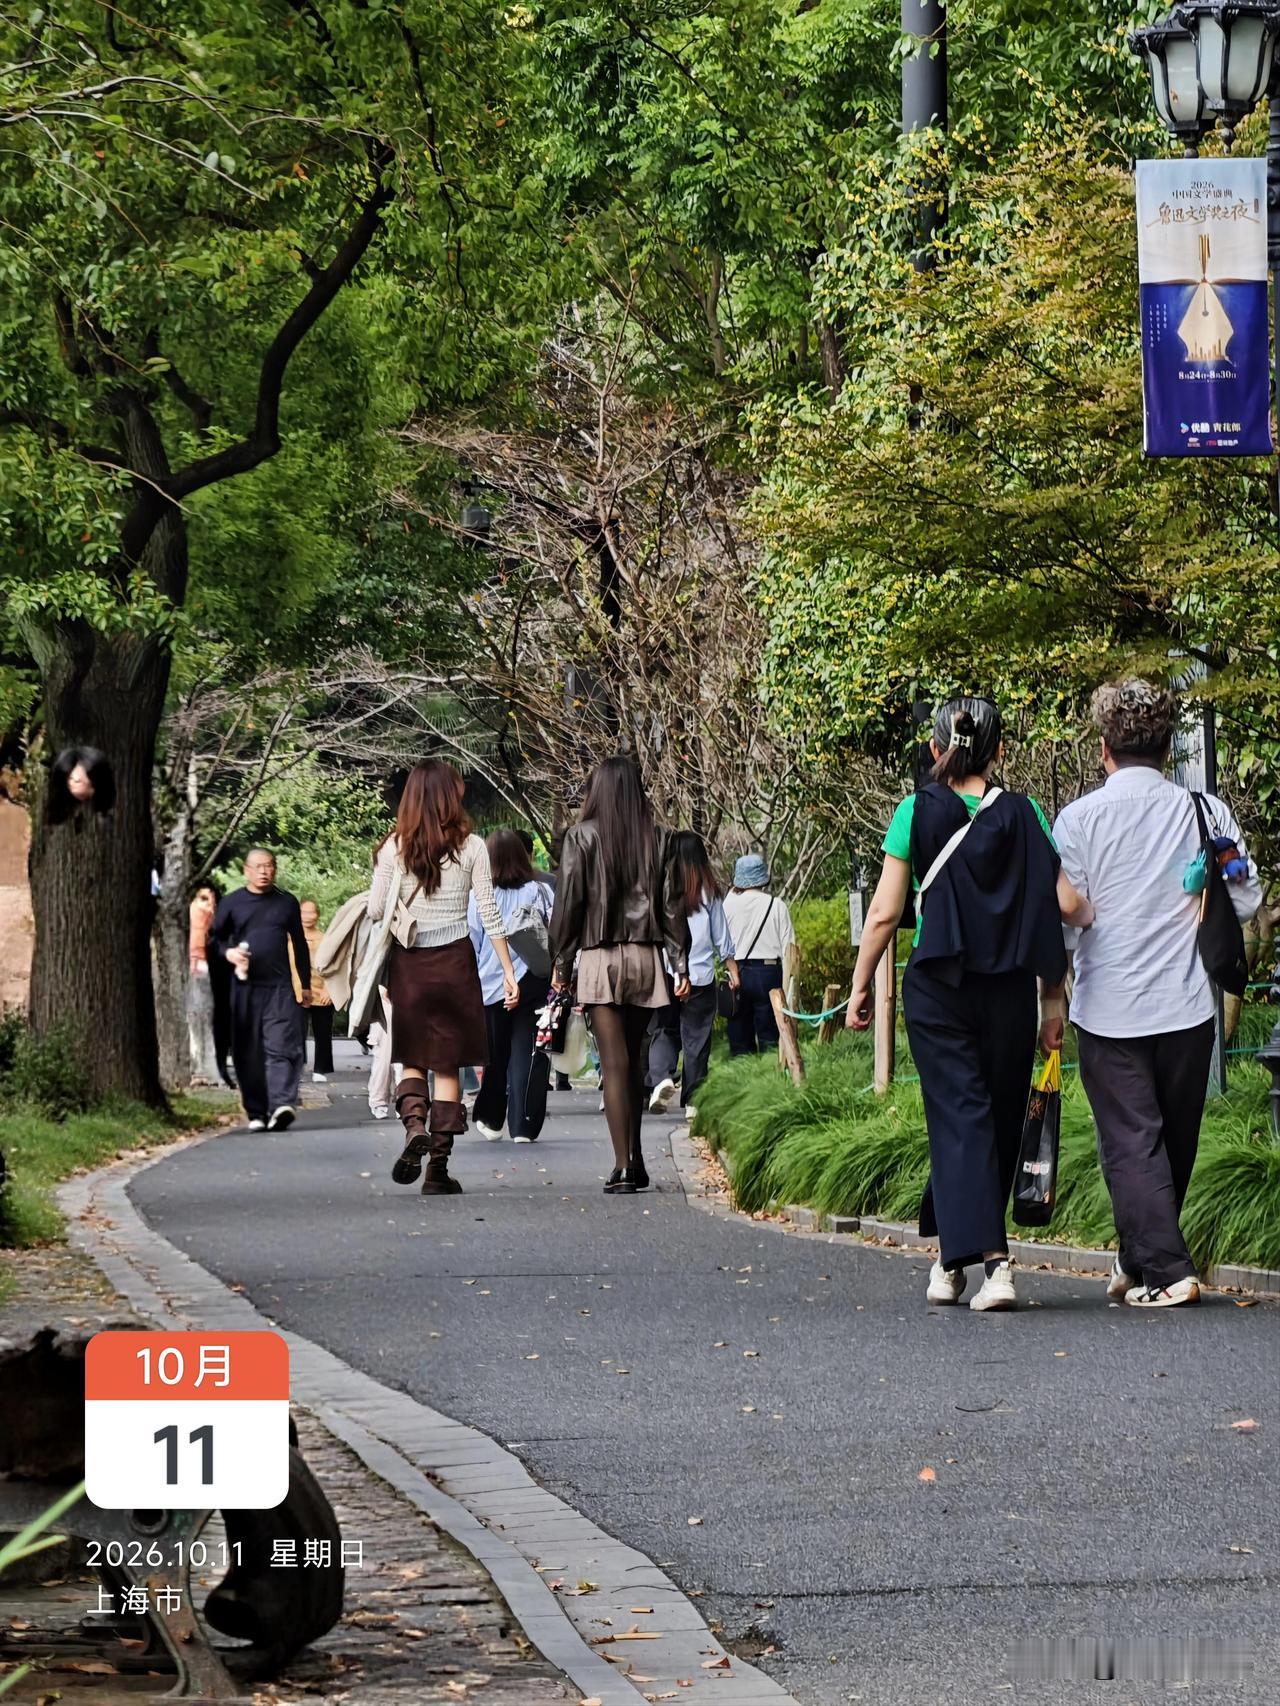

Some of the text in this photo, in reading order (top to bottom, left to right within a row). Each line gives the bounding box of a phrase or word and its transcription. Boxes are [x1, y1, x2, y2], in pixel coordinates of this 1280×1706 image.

[1191, 181, 1214, 190] 2026
[1172, 189, 1233, 200] 中国文学盛典
[1147, 199, 1260, 228] 鲁迅文学奖之夜
